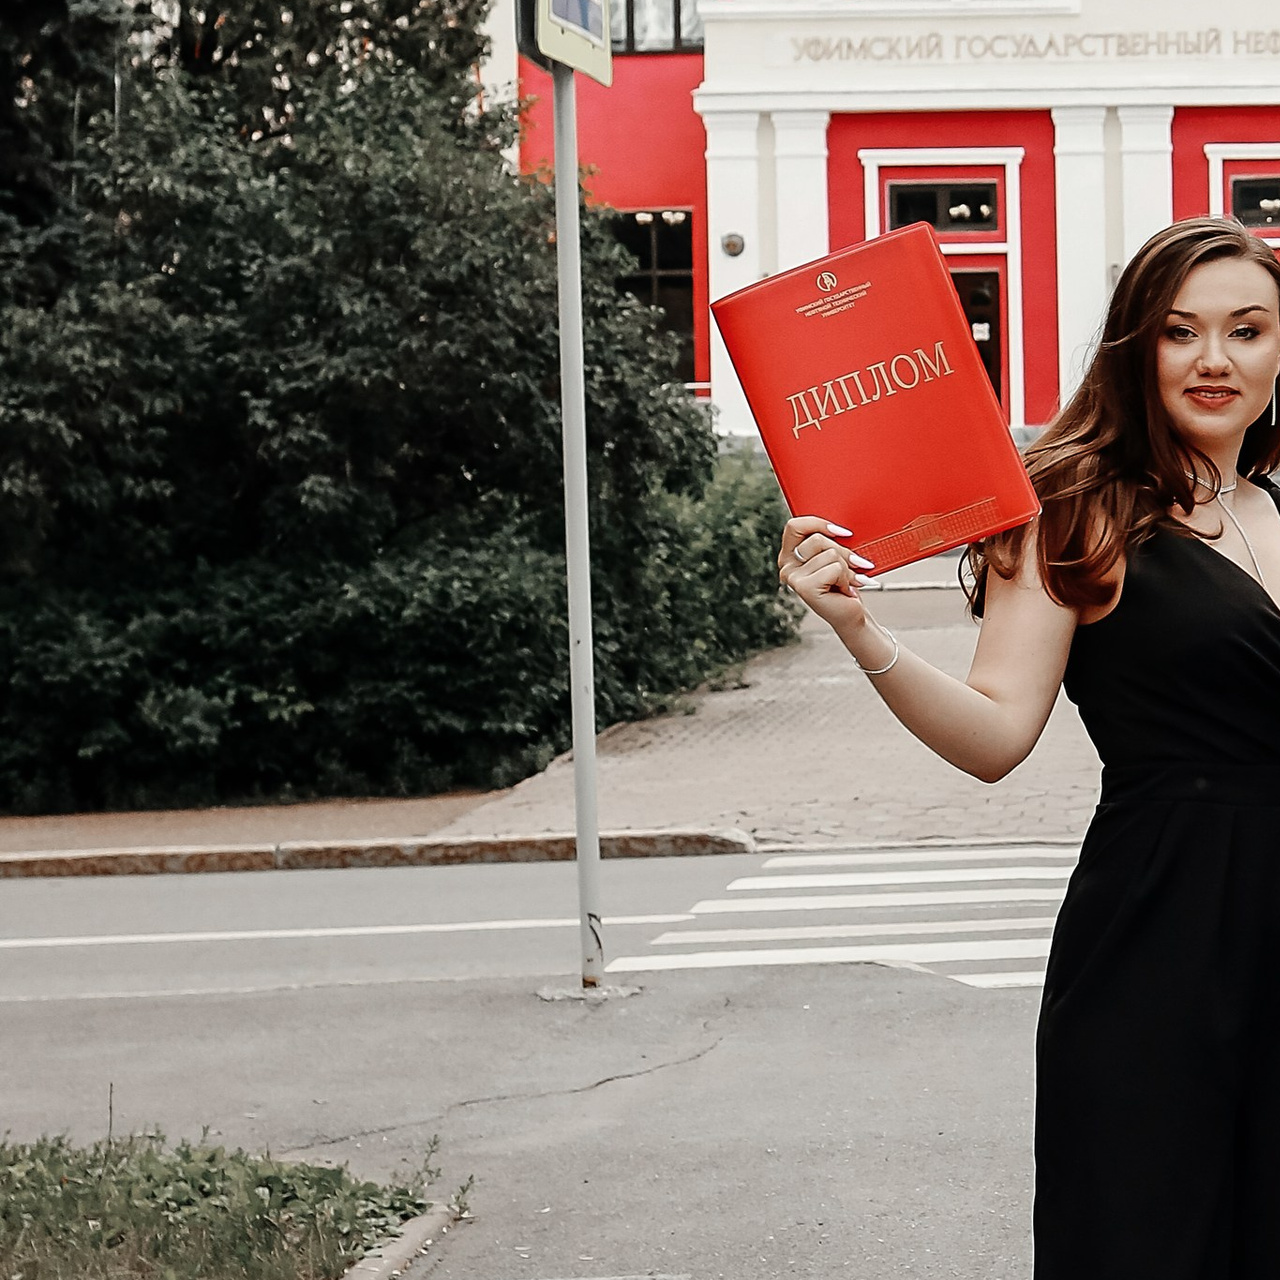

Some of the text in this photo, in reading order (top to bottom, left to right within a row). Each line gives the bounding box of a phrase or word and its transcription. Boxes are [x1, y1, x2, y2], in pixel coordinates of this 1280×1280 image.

[790, 33, 943, 61] УФИМСКИЙ
[954, 28, 1222, 59] ГОСУДАРСТВЕННЫЙ
[786, 340, 955, 439] ДИПЛОМ
